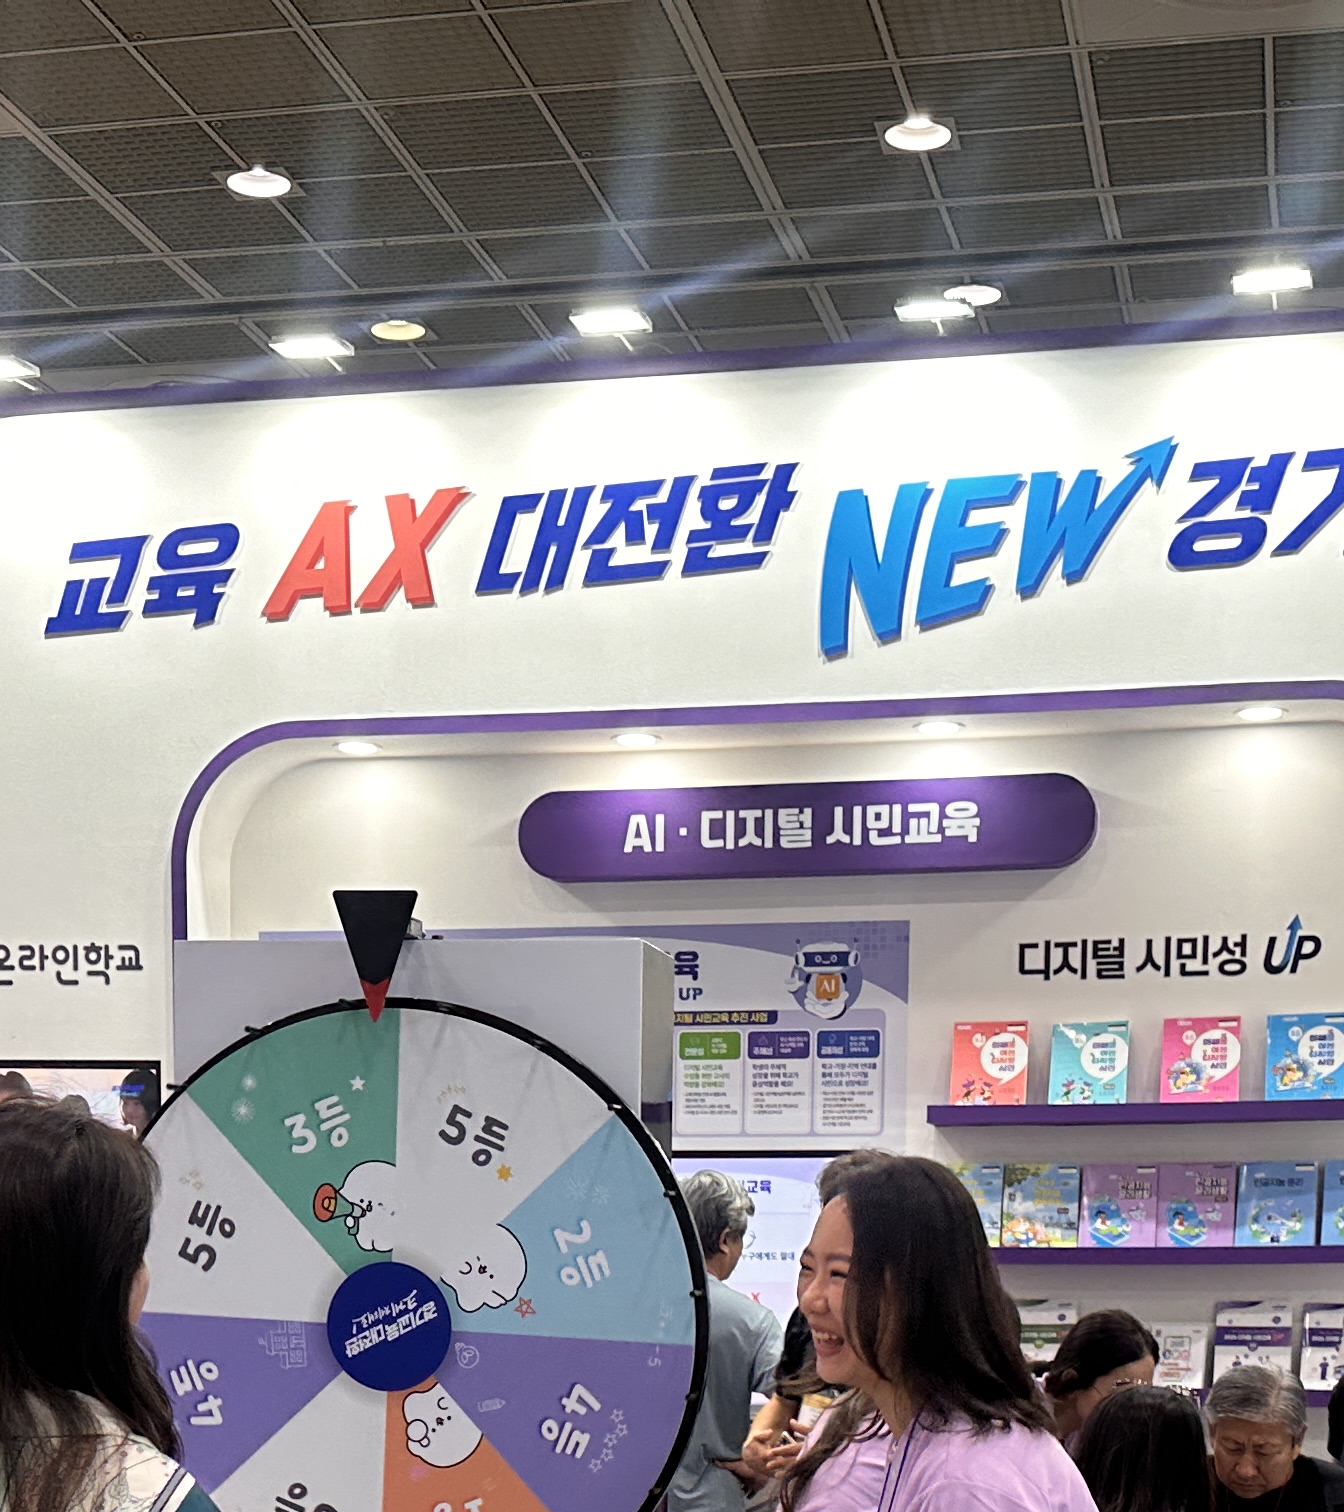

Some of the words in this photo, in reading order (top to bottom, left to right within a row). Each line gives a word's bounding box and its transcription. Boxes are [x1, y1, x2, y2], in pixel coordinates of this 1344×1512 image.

[44, 522, 242, 639] 교육
[260, 485, 473, 623] AX
[474, 461, 803, 599] 대전환
[819, 436, 1178, 664] NEW
[623, 813, 666, 854] AI
[700, 808, 813, 851] 디지털
[826, 801, 981, 847] 시민교육
[1018, 938, 1126, 981] 디지털
[1136, 934, 1249, 978] 시민성
[1263, 917, 1321, 975] UP
[674, 1011, 693, 1023] 지털
[678, 987, 703, 1001] UP
[819, 979, 836, 993] AI
[283, 1095, 351, 1155] 3등
[437, 1103, 511, 1167] 5등
[741, 1179, 772, 1195] 교육
[178, 1199, 237, 1273] 5등
[553, 1218, 612, 1290] 2등
[170, 1357, 223, 1427] 4등
[540, 1382, 602, 1459] 4등
